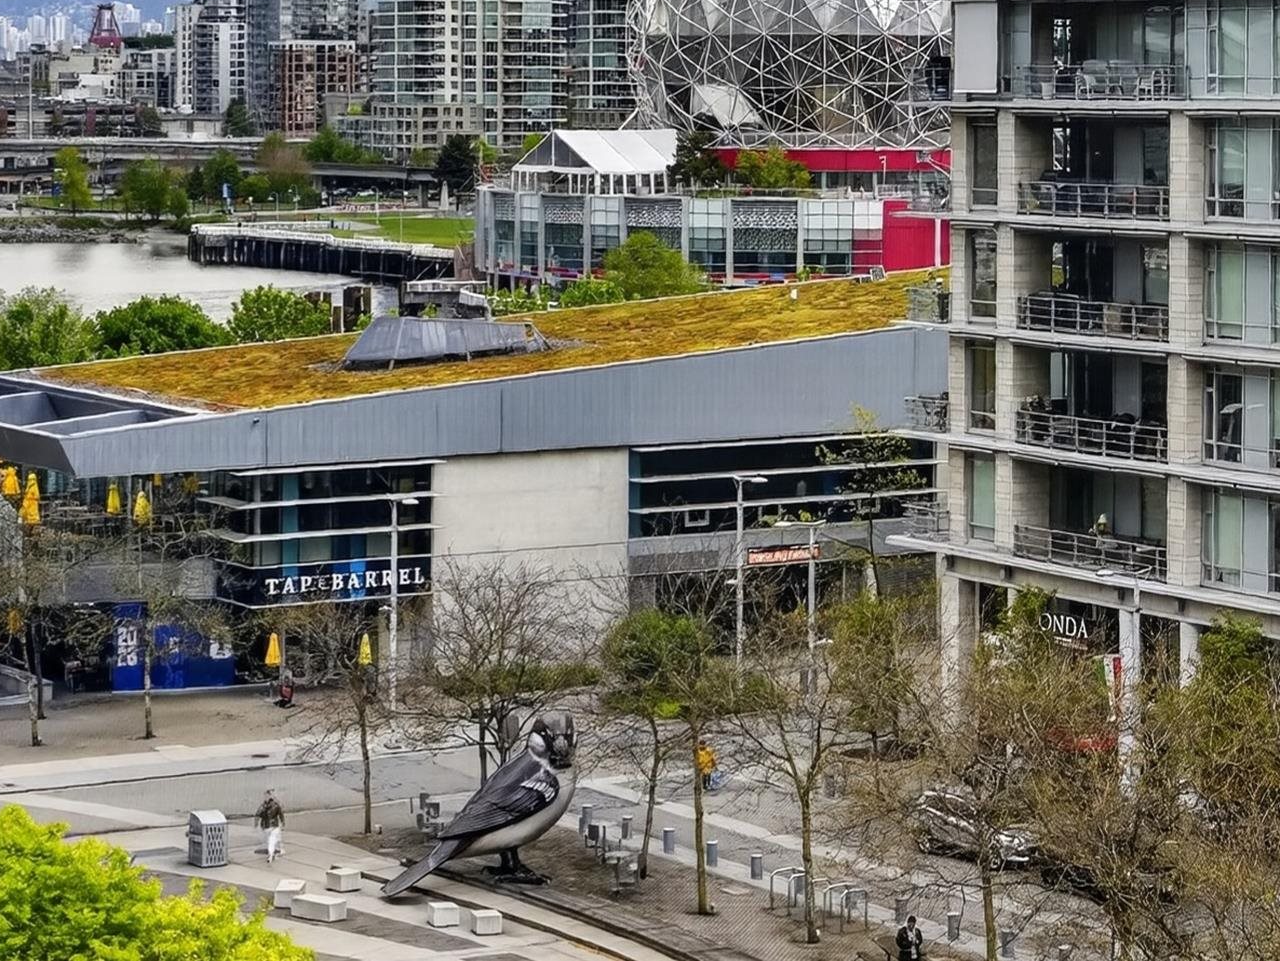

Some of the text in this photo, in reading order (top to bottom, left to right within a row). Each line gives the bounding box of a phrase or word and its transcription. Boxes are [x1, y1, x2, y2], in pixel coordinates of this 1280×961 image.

[264, 575, 312, 596] TAP
[331, 567, 425, 590] BARREL
[1038, 612, 1089, 639] ONDA
